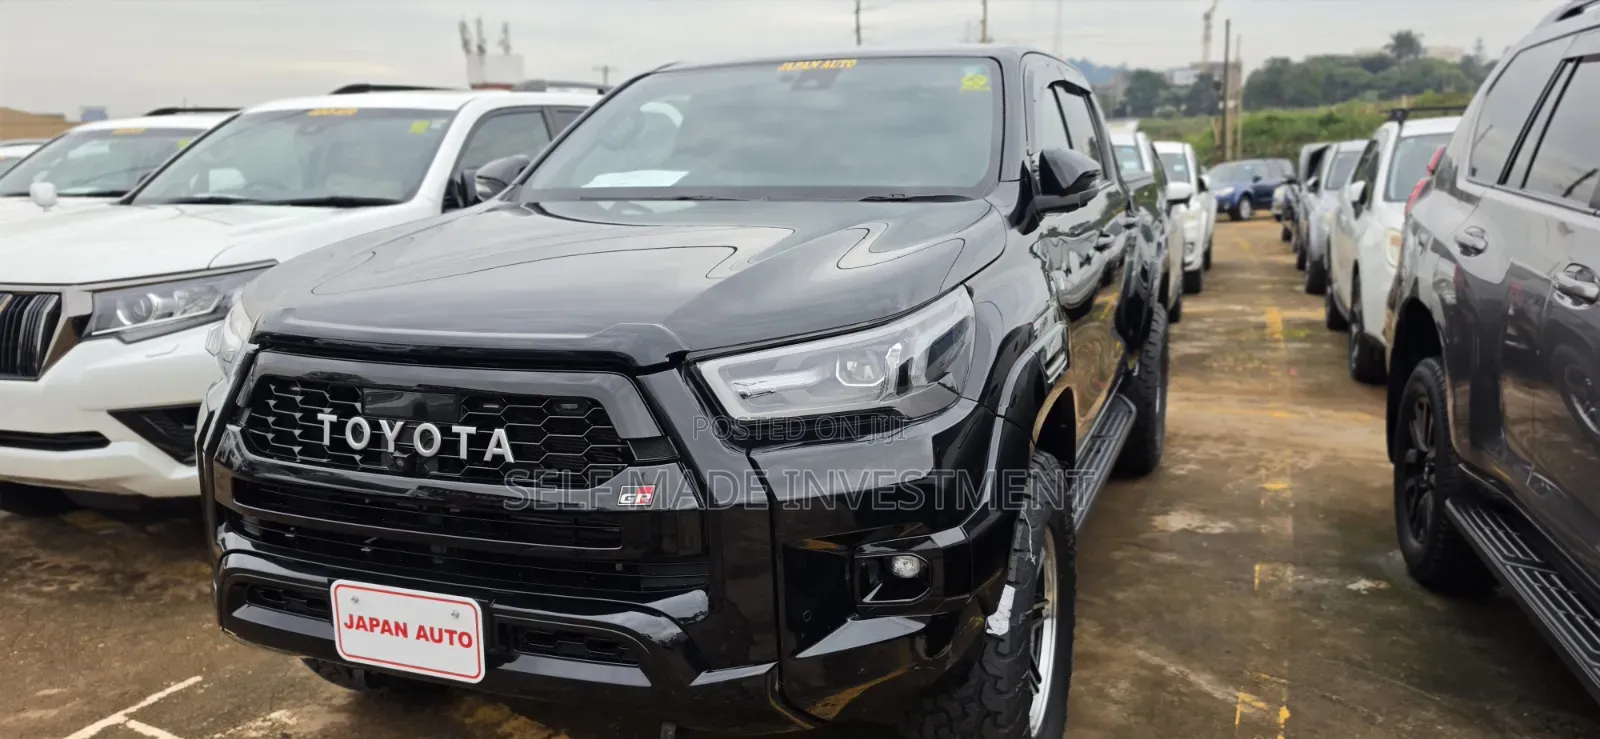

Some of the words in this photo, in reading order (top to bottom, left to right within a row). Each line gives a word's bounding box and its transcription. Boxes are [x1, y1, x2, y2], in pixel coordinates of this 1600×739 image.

[777, 61, 821, 71] JAPAN
[820, 59, 857, 69] AUTO
[317, 413, 515, 463] TOYOTA
[620, 493, 652, 505] GR
[343, 613, 409, 639] JAPAN
[415, 625, 473, 649] AUTO
